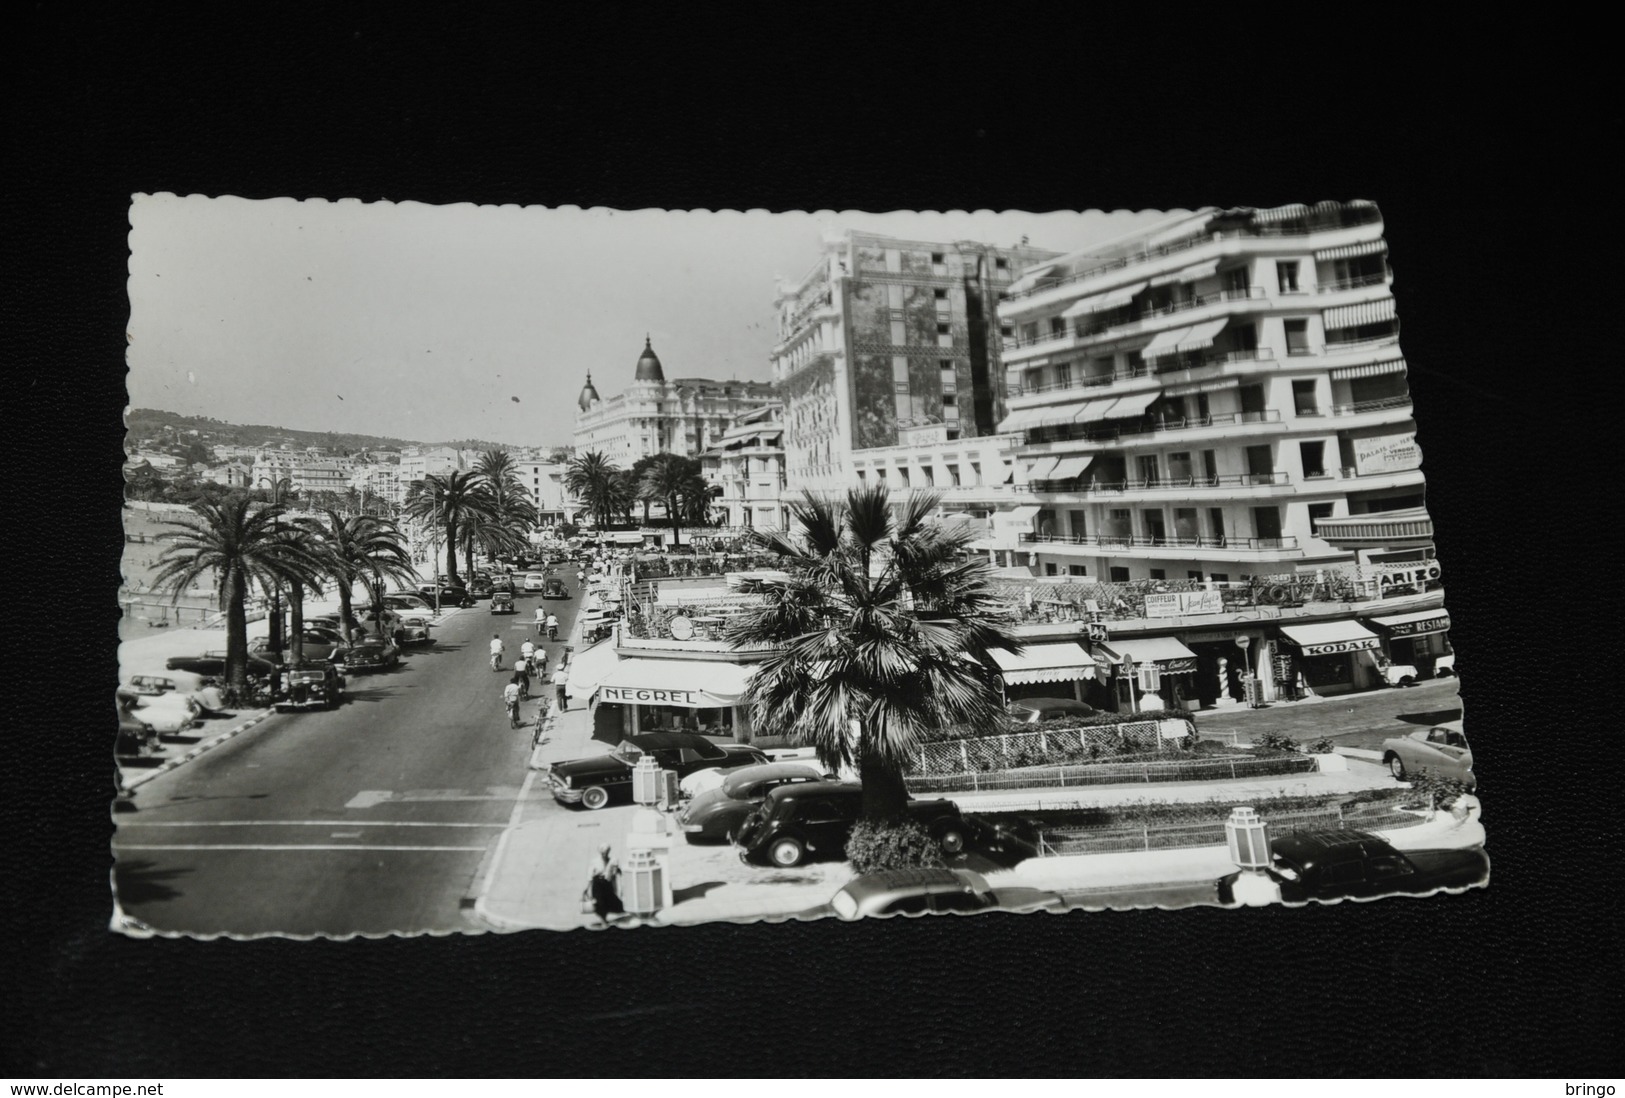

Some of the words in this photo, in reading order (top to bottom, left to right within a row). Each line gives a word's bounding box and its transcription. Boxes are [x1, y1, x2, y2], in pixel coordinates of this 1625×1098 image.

[1360, 446, 1388, 462] PALAIS
[1381, 567, 1440, 586] ARIZO
[1147, 594, 1177, 603] COIFFEUR
[1308, 640, 1374, 655] KODAK
[605, 689, 697, 704] NEGREL
